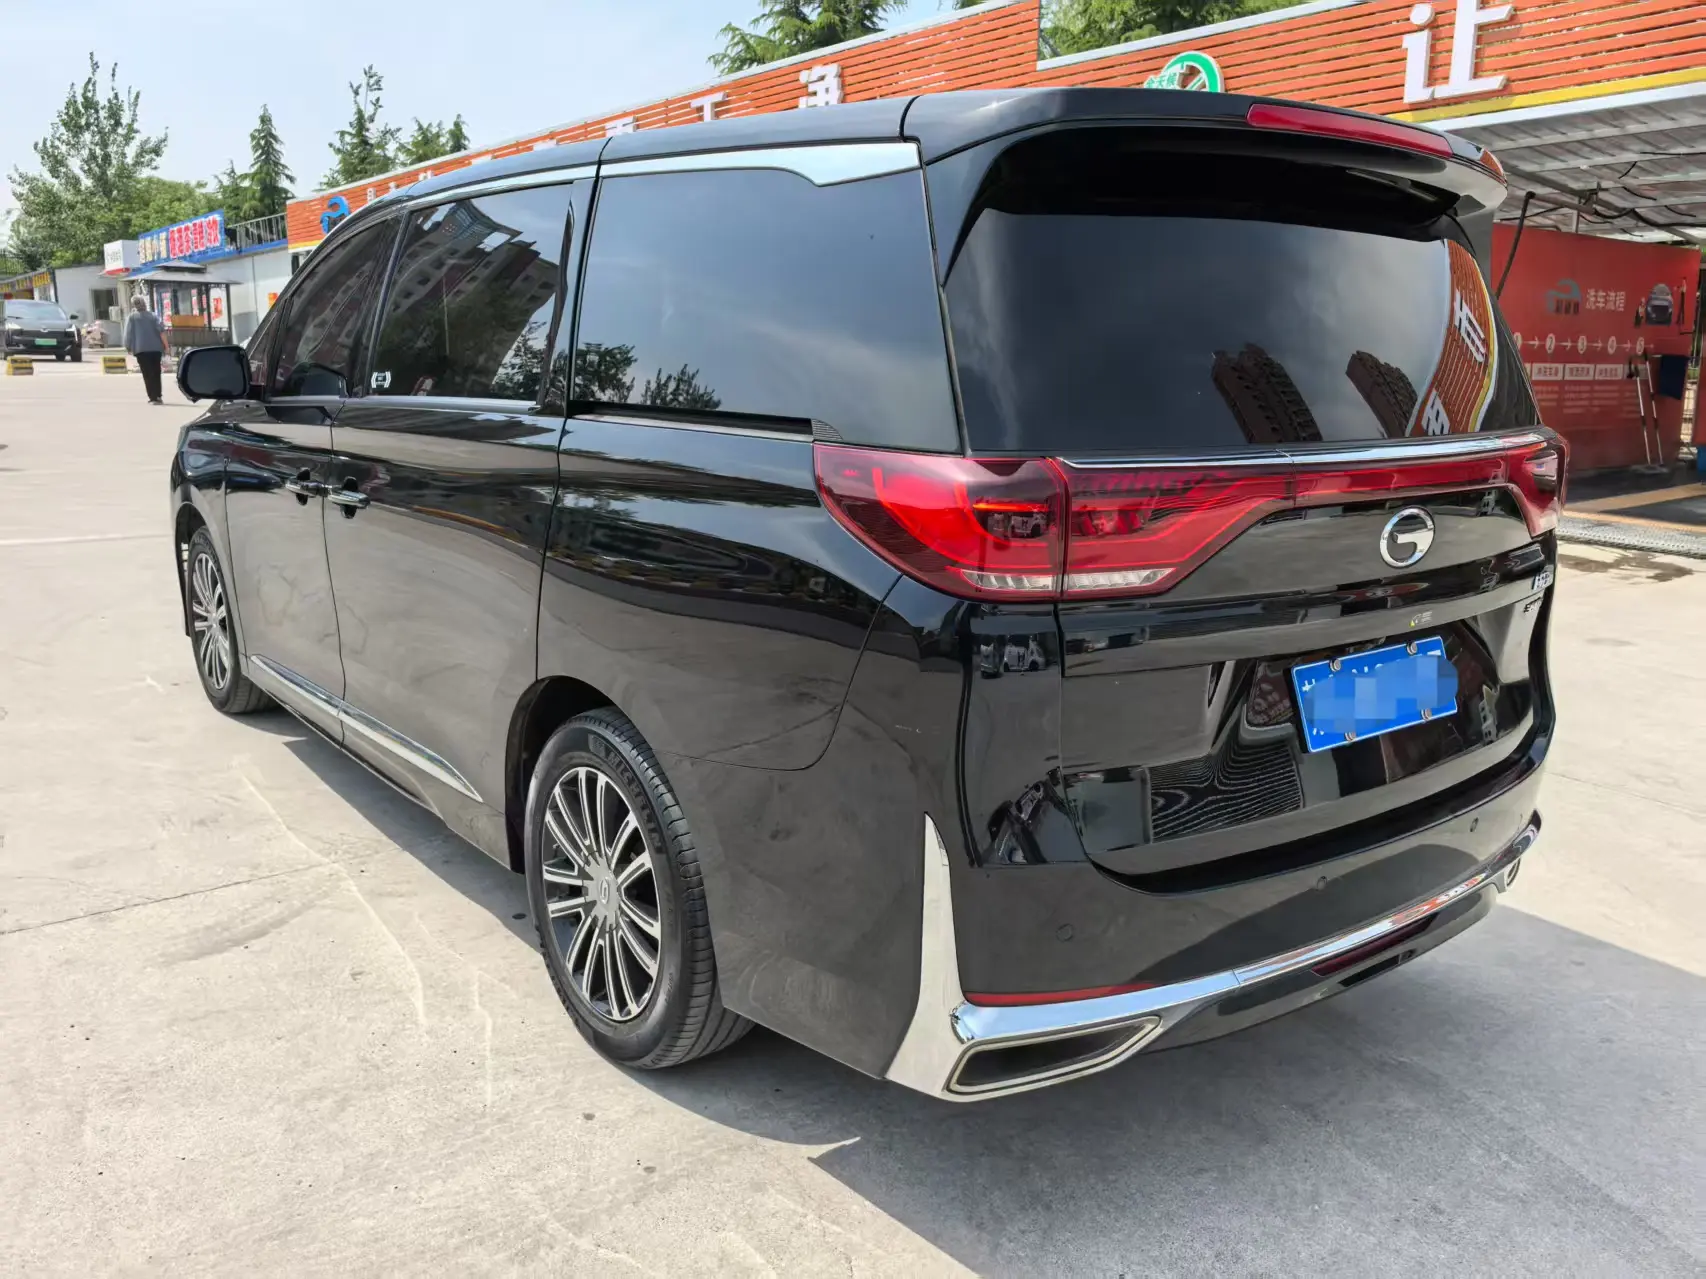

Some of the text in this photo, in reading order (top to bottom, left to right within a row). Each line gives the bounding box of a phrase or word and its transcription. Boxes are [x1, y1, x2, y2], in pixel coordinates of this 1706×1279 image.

[1401, 0, 1513, 104] 让
[1586, 288, 1626, 312] 洗车流程
